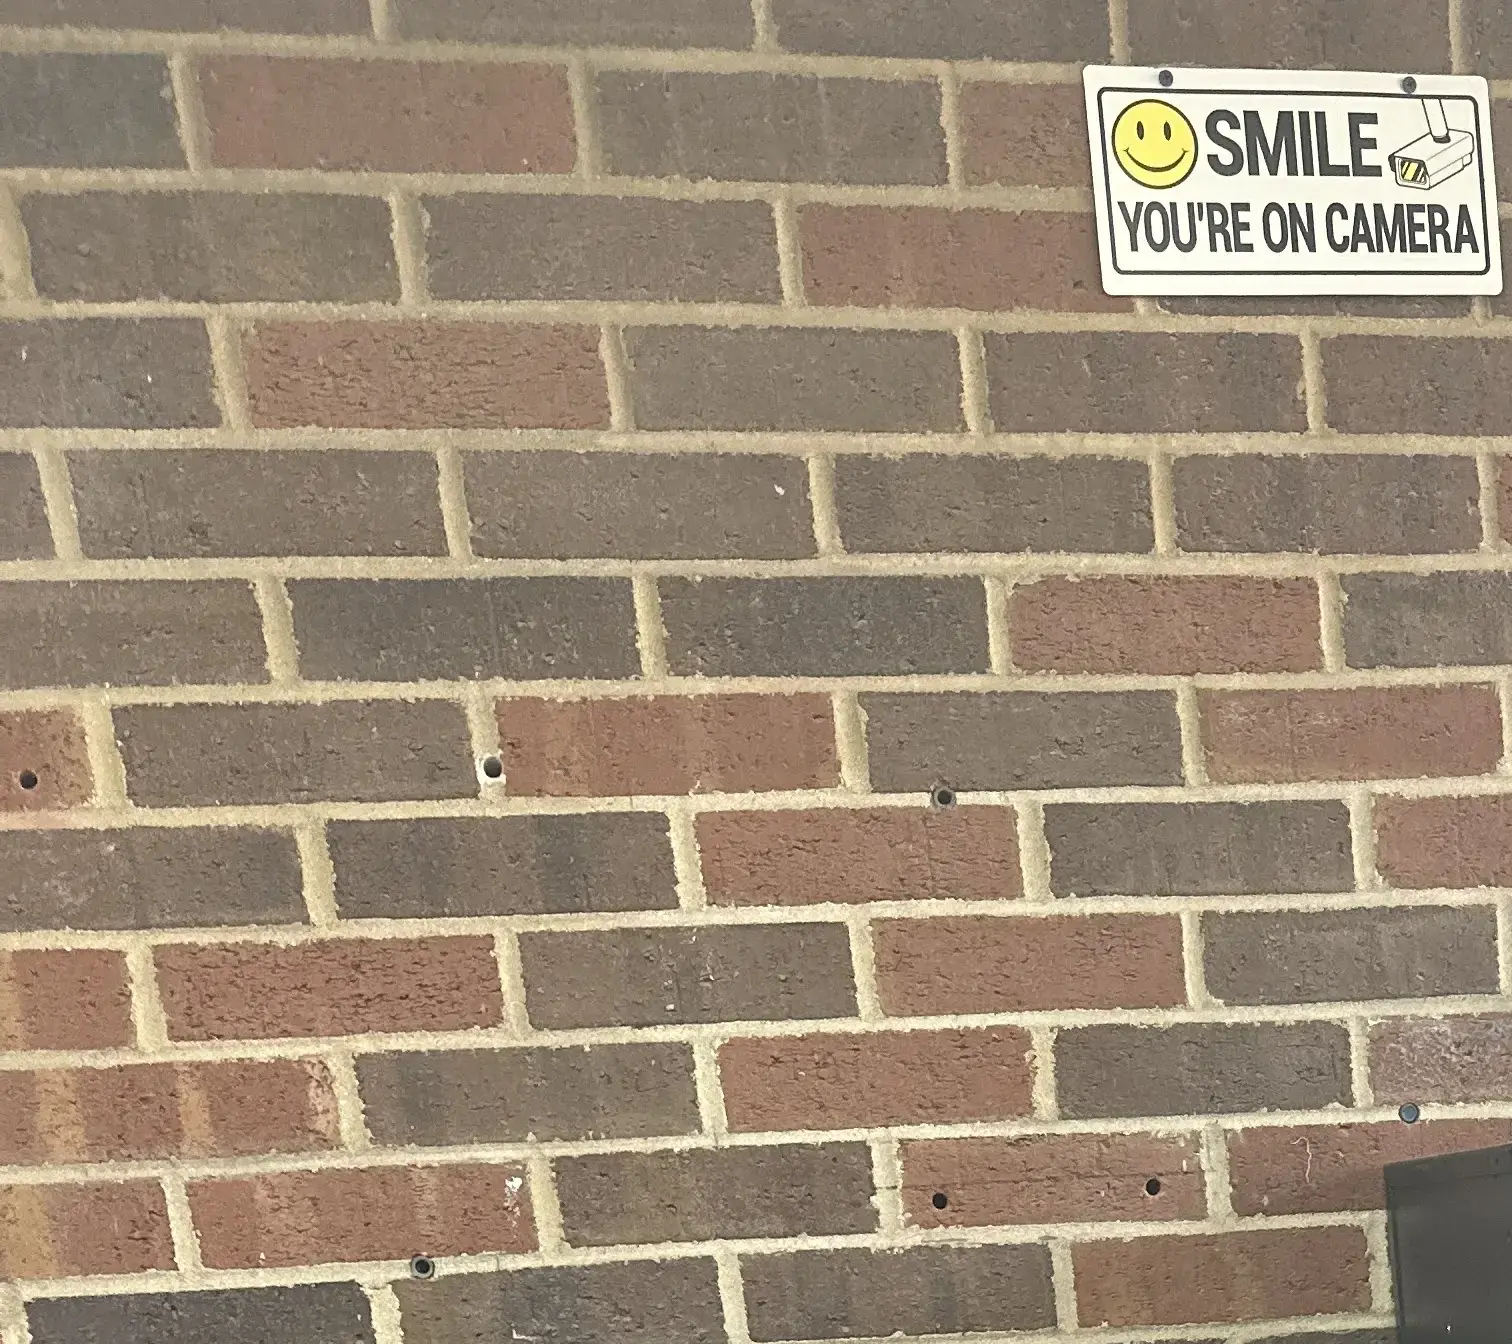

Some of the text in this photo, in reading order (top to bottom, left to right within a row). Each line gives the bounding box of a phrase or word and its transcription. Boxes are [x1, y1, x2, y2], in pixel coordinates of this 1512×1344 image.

[1205, 109, 1382, 177] SMILE
[1117, 201, 1480, 254] YOU'RE ON CAMERA
